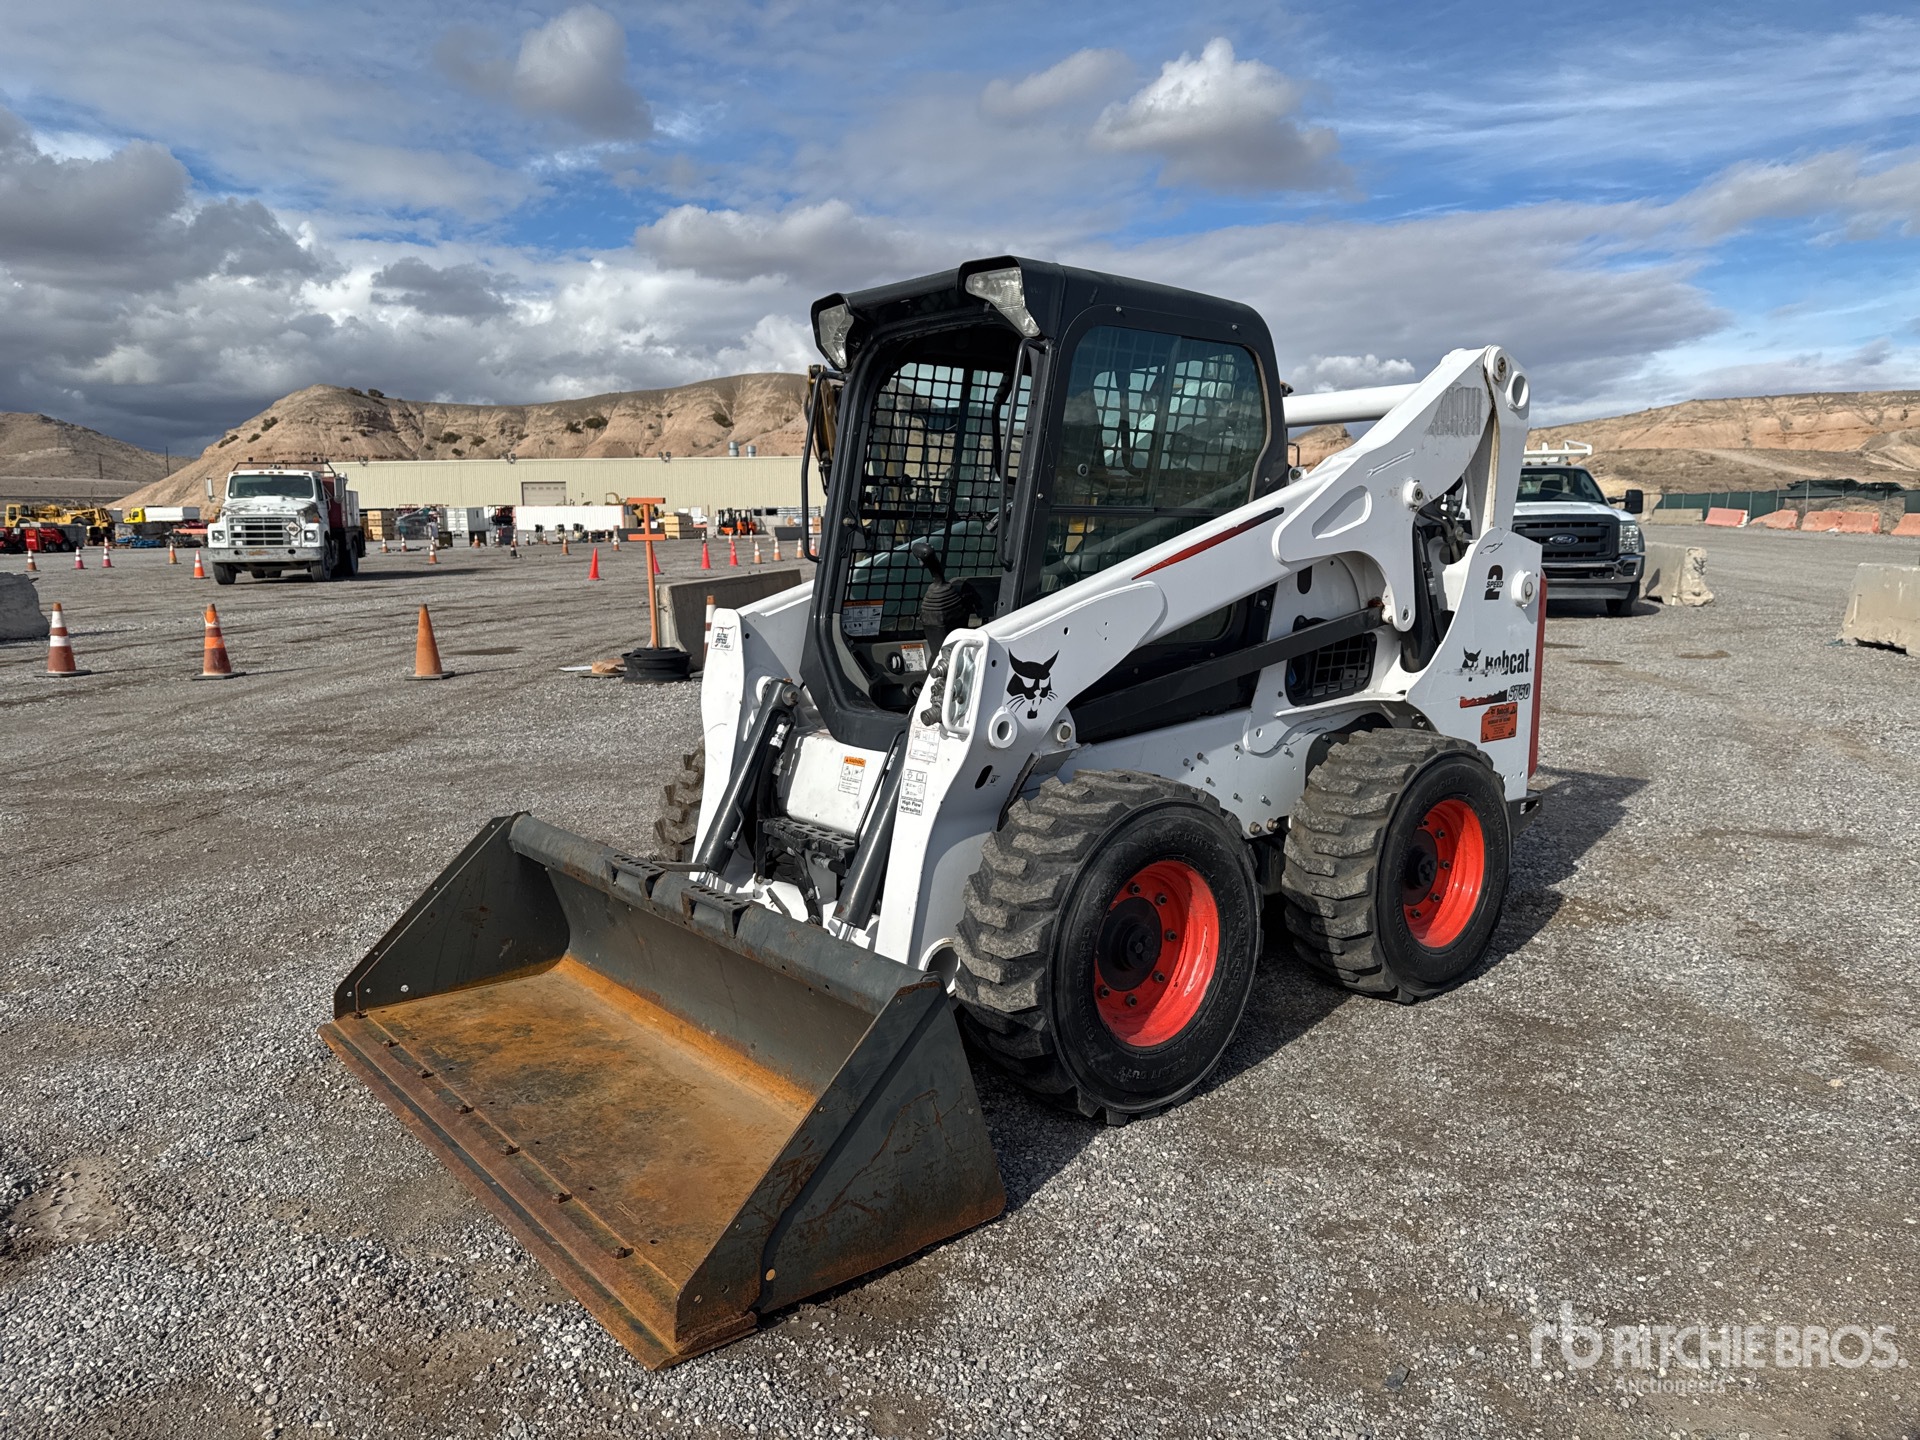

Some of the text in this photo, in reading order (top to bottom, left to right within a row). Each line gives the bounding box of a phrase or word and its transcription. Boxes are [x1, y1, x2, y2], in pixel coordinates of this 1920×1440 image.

[1484, 564, 1504, 600] 2
[1486, 580, 1504, 588] SPEED
[1508, 683, 1531, 701] S750
